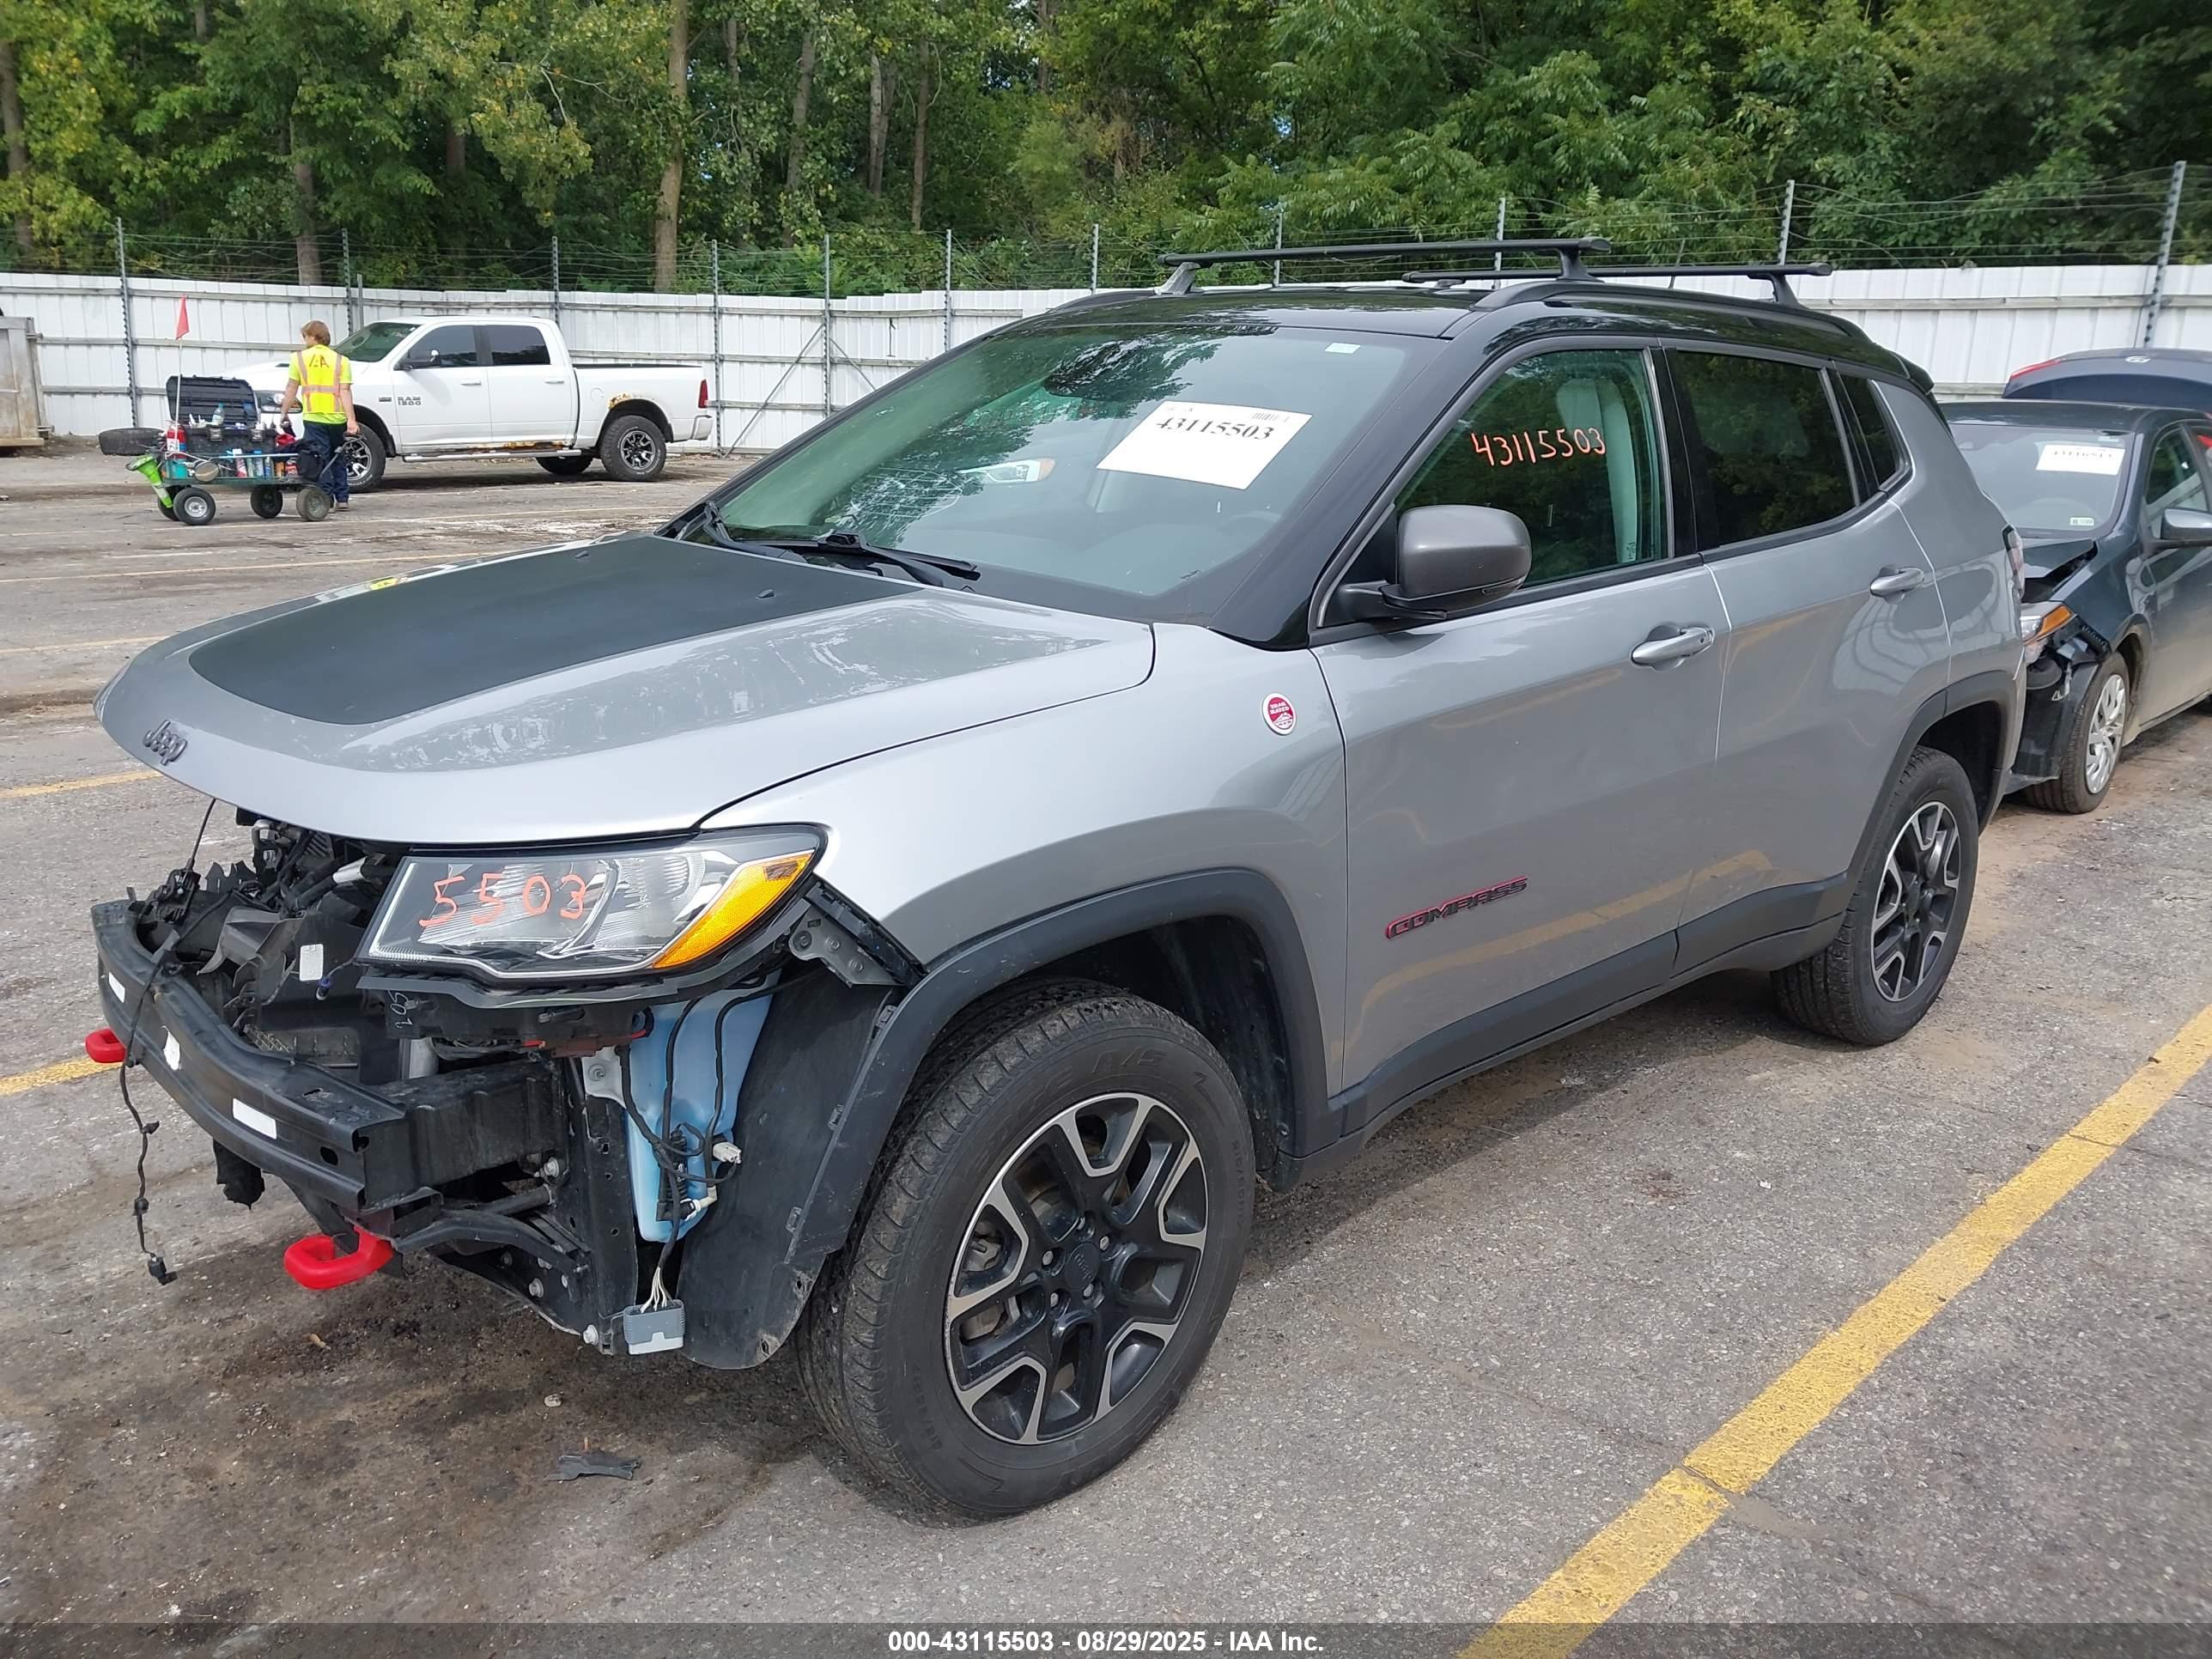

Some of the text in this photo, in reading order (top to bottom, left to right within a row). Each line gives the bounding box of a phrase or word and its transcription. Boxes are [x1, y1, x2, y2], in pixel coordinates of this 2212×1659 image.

[1156, 417, 1275, 440] 43115503
[1470, 428, 1607, 466] 43115503
[143, 720, 188, 766] Jeep
[418, 872, 586, 927] 5503
[1385, 876, 1528, 939] COMPASS
